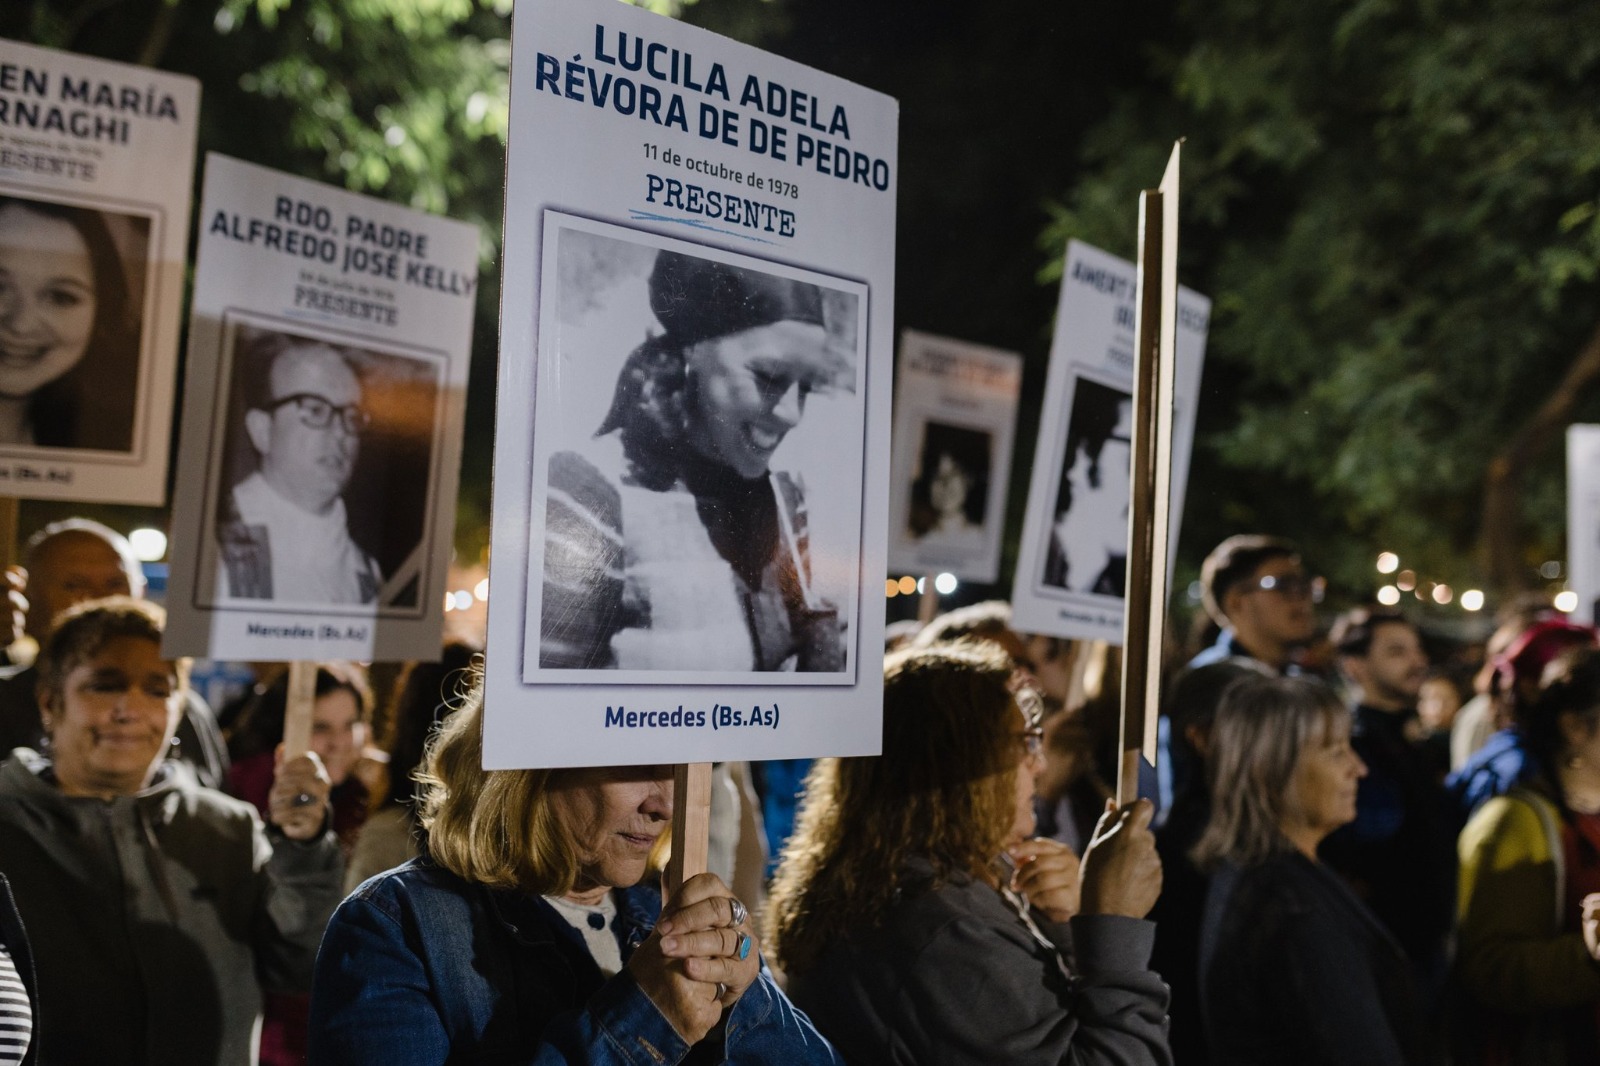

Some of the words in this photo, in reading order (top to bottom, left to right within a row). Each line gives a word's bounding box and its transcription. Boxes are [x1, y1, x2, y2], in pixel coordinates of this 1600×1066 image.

[61, 74, 179, 122] MARÍA
[595, 24, 730, 101] LUCILA
[740, 75, 851, 140] ADELA
[535, 52, 689, 133] RÉVORA
[699, 105, 739, 147] DE
[749, 119, 787, 162] DE
[797, 132, 889, 192] PEDRO
[643, 143, 658, 160] 11
[662, 148, 681, 166] de
[686, 157, 743, 184] octubre
[747, 172, 764, 189] de
[768, 178, 799, 199] 1978
[275, 195, 338, 235] RDO.
[347, 215, 428, 258] PADRE
[645, 174, 796, 237] PRESENTE
[210, 209, 337, 263] ALFREDO
[343, 246, 399, 281] JOSÉ
[406, 261, 478, 298] KELLY
[294, 284, 398, 326] PRESENTE
[604, 705, 706, 728] Mercedes
[711, 703, 780, 731] (Bs.As)
